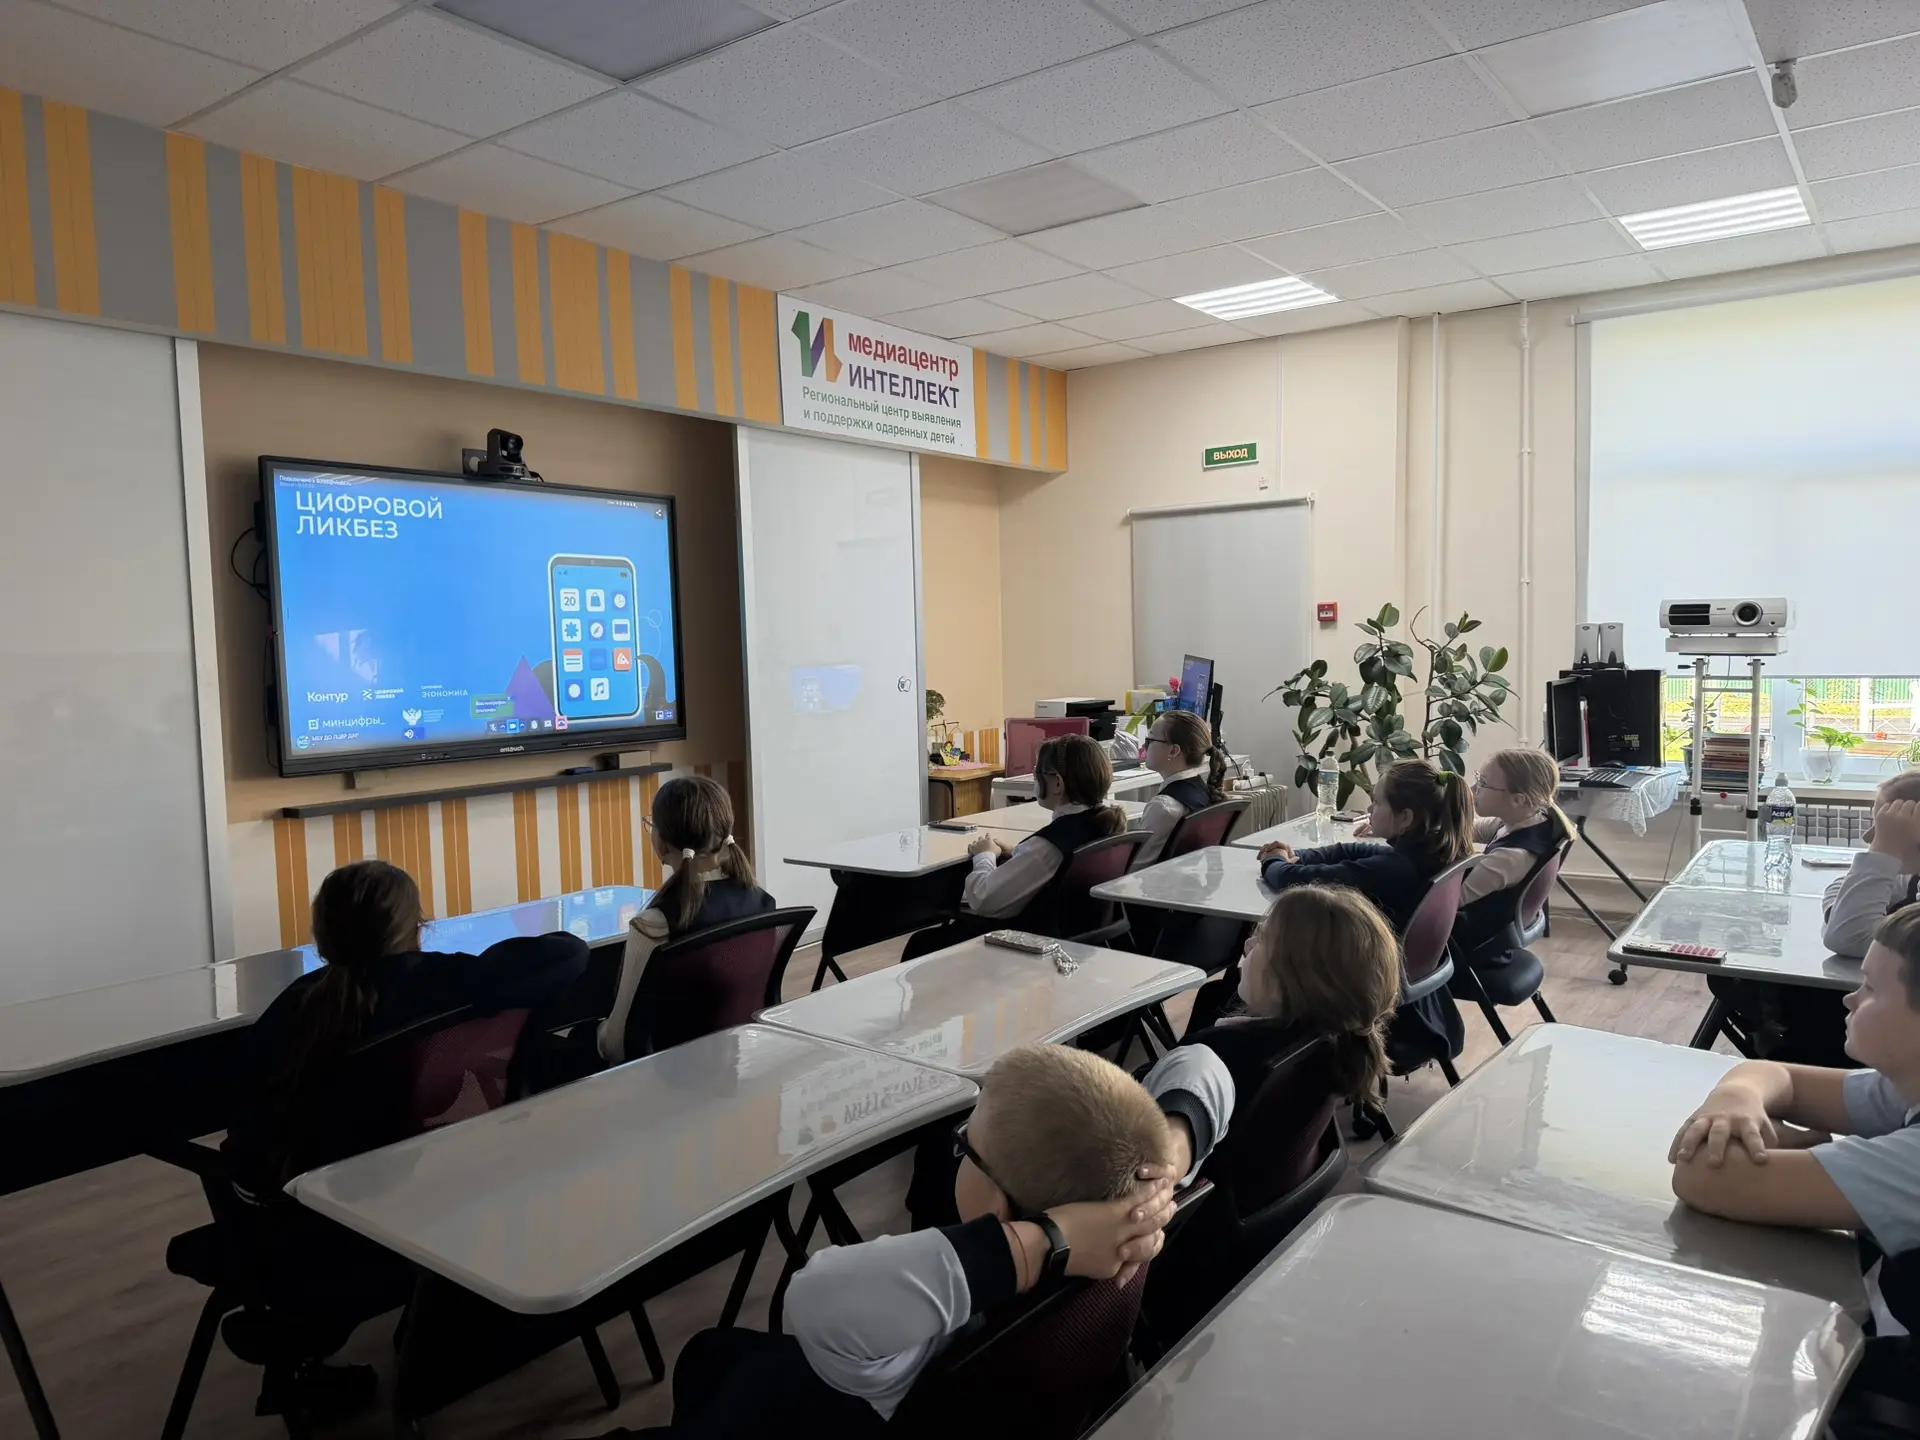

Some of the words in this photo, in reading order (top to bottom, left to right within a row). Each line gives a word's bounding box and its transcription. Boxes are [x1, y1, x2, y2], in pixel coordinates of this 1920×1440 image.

[848, 332, 959, 381] медиацентр
[848, 363, 960, 409] ИНТЕЛЛЕКТ
[802, 385, 880, 413] Региональный
[881, 404, 910, 420] центр
[911, 410, 962, 429] выявления
[803, 409, 811, 420] и
[813, 410, 873, 430] поддержки
[875, 422, 928, 441] одаренных
[930, 432, 956, 445] детей
[1213, 448, 1248, 460] ВЫХОД
[295, 490, 443, 519] ЦИФРОВОЙ
[296, 515, 399, 539] ЛИКБЕЗ
[564, 596, 576, 606] 20
[307, 691, 349, 703] Контур
[421, 688, 469, 698] ЭКОНОМИКА
